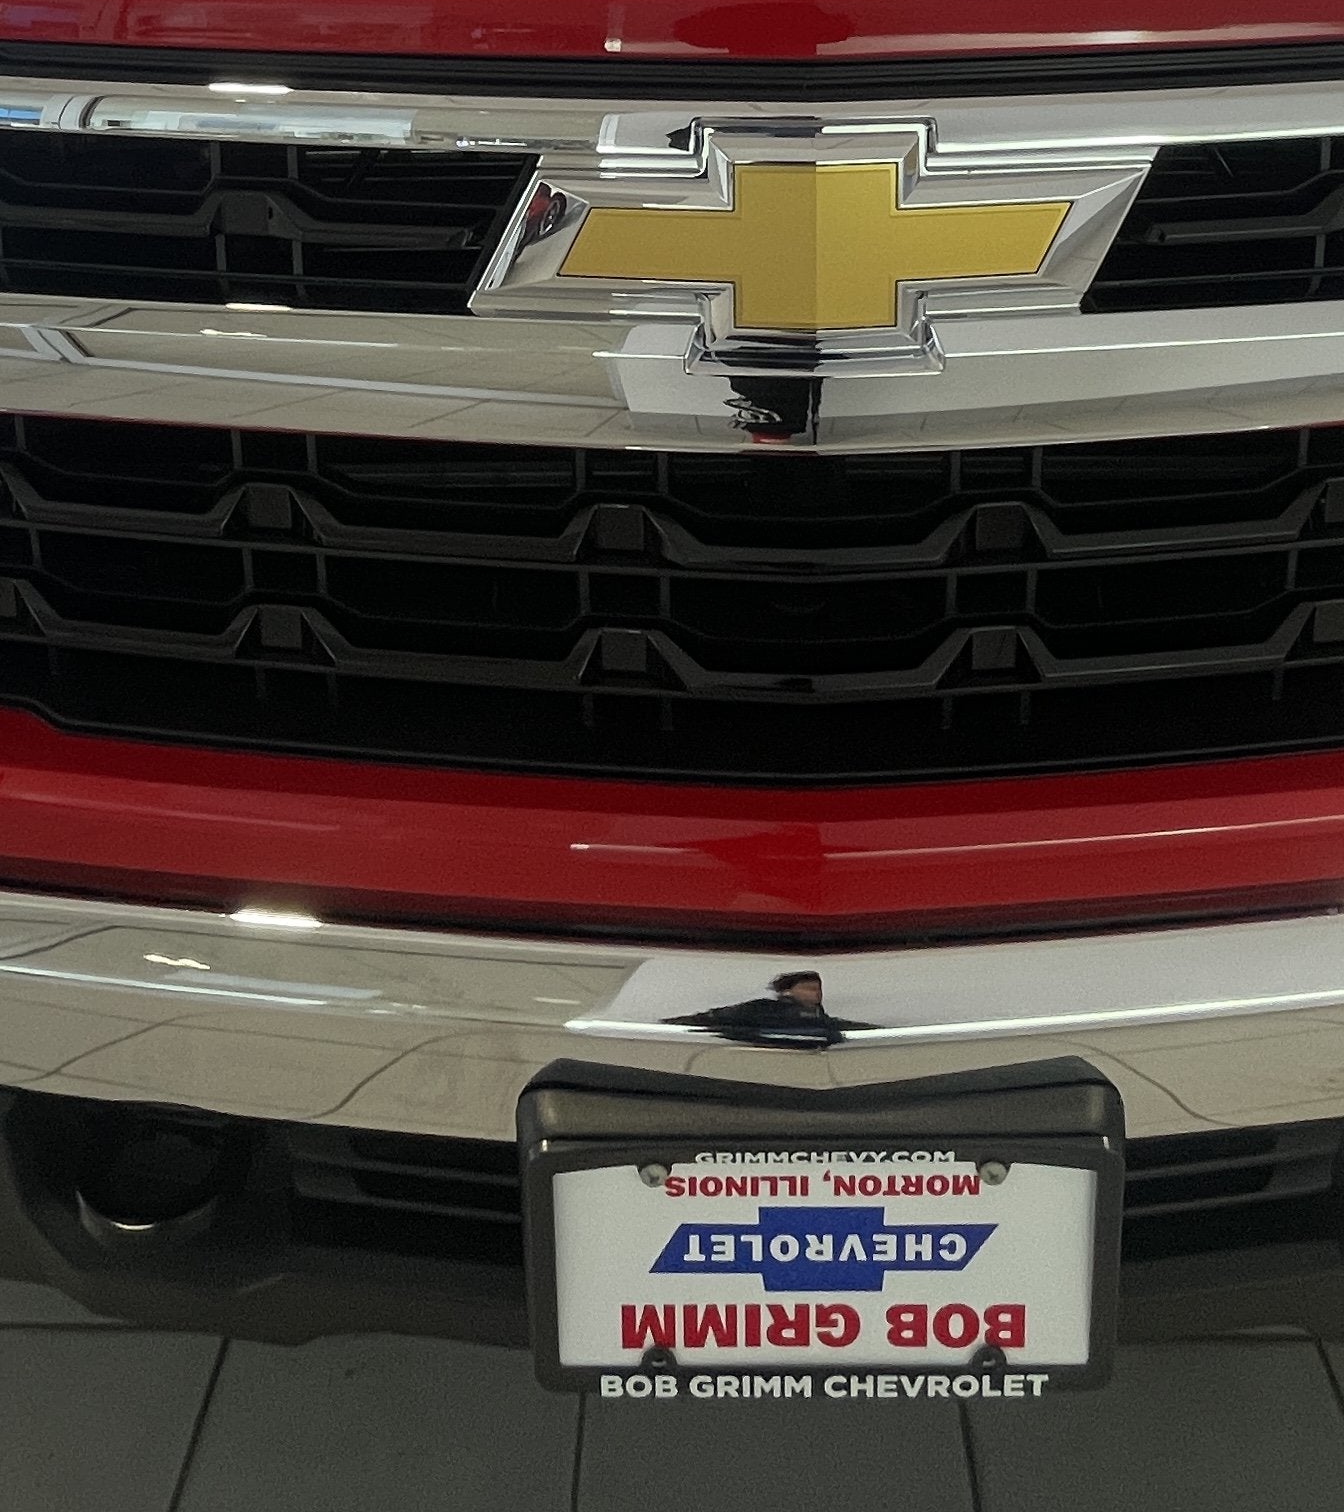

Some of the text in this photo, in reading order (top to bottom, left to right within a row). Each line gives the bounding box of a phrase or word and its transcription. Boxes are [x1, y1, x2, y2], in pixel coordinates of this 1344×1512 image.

[695, 1150, 956, 1165] GRIMMCHEVY.COM
[664, 1170, 981, 1197] MORTON, ILLINOIS
[682, 1233, 968, 1263] CHEVROLET
[620, 1303, 1027, 1350] BOB GRIMM
[599, 1373, 1050, 1399] BOB GRIMM CHEVROLET
